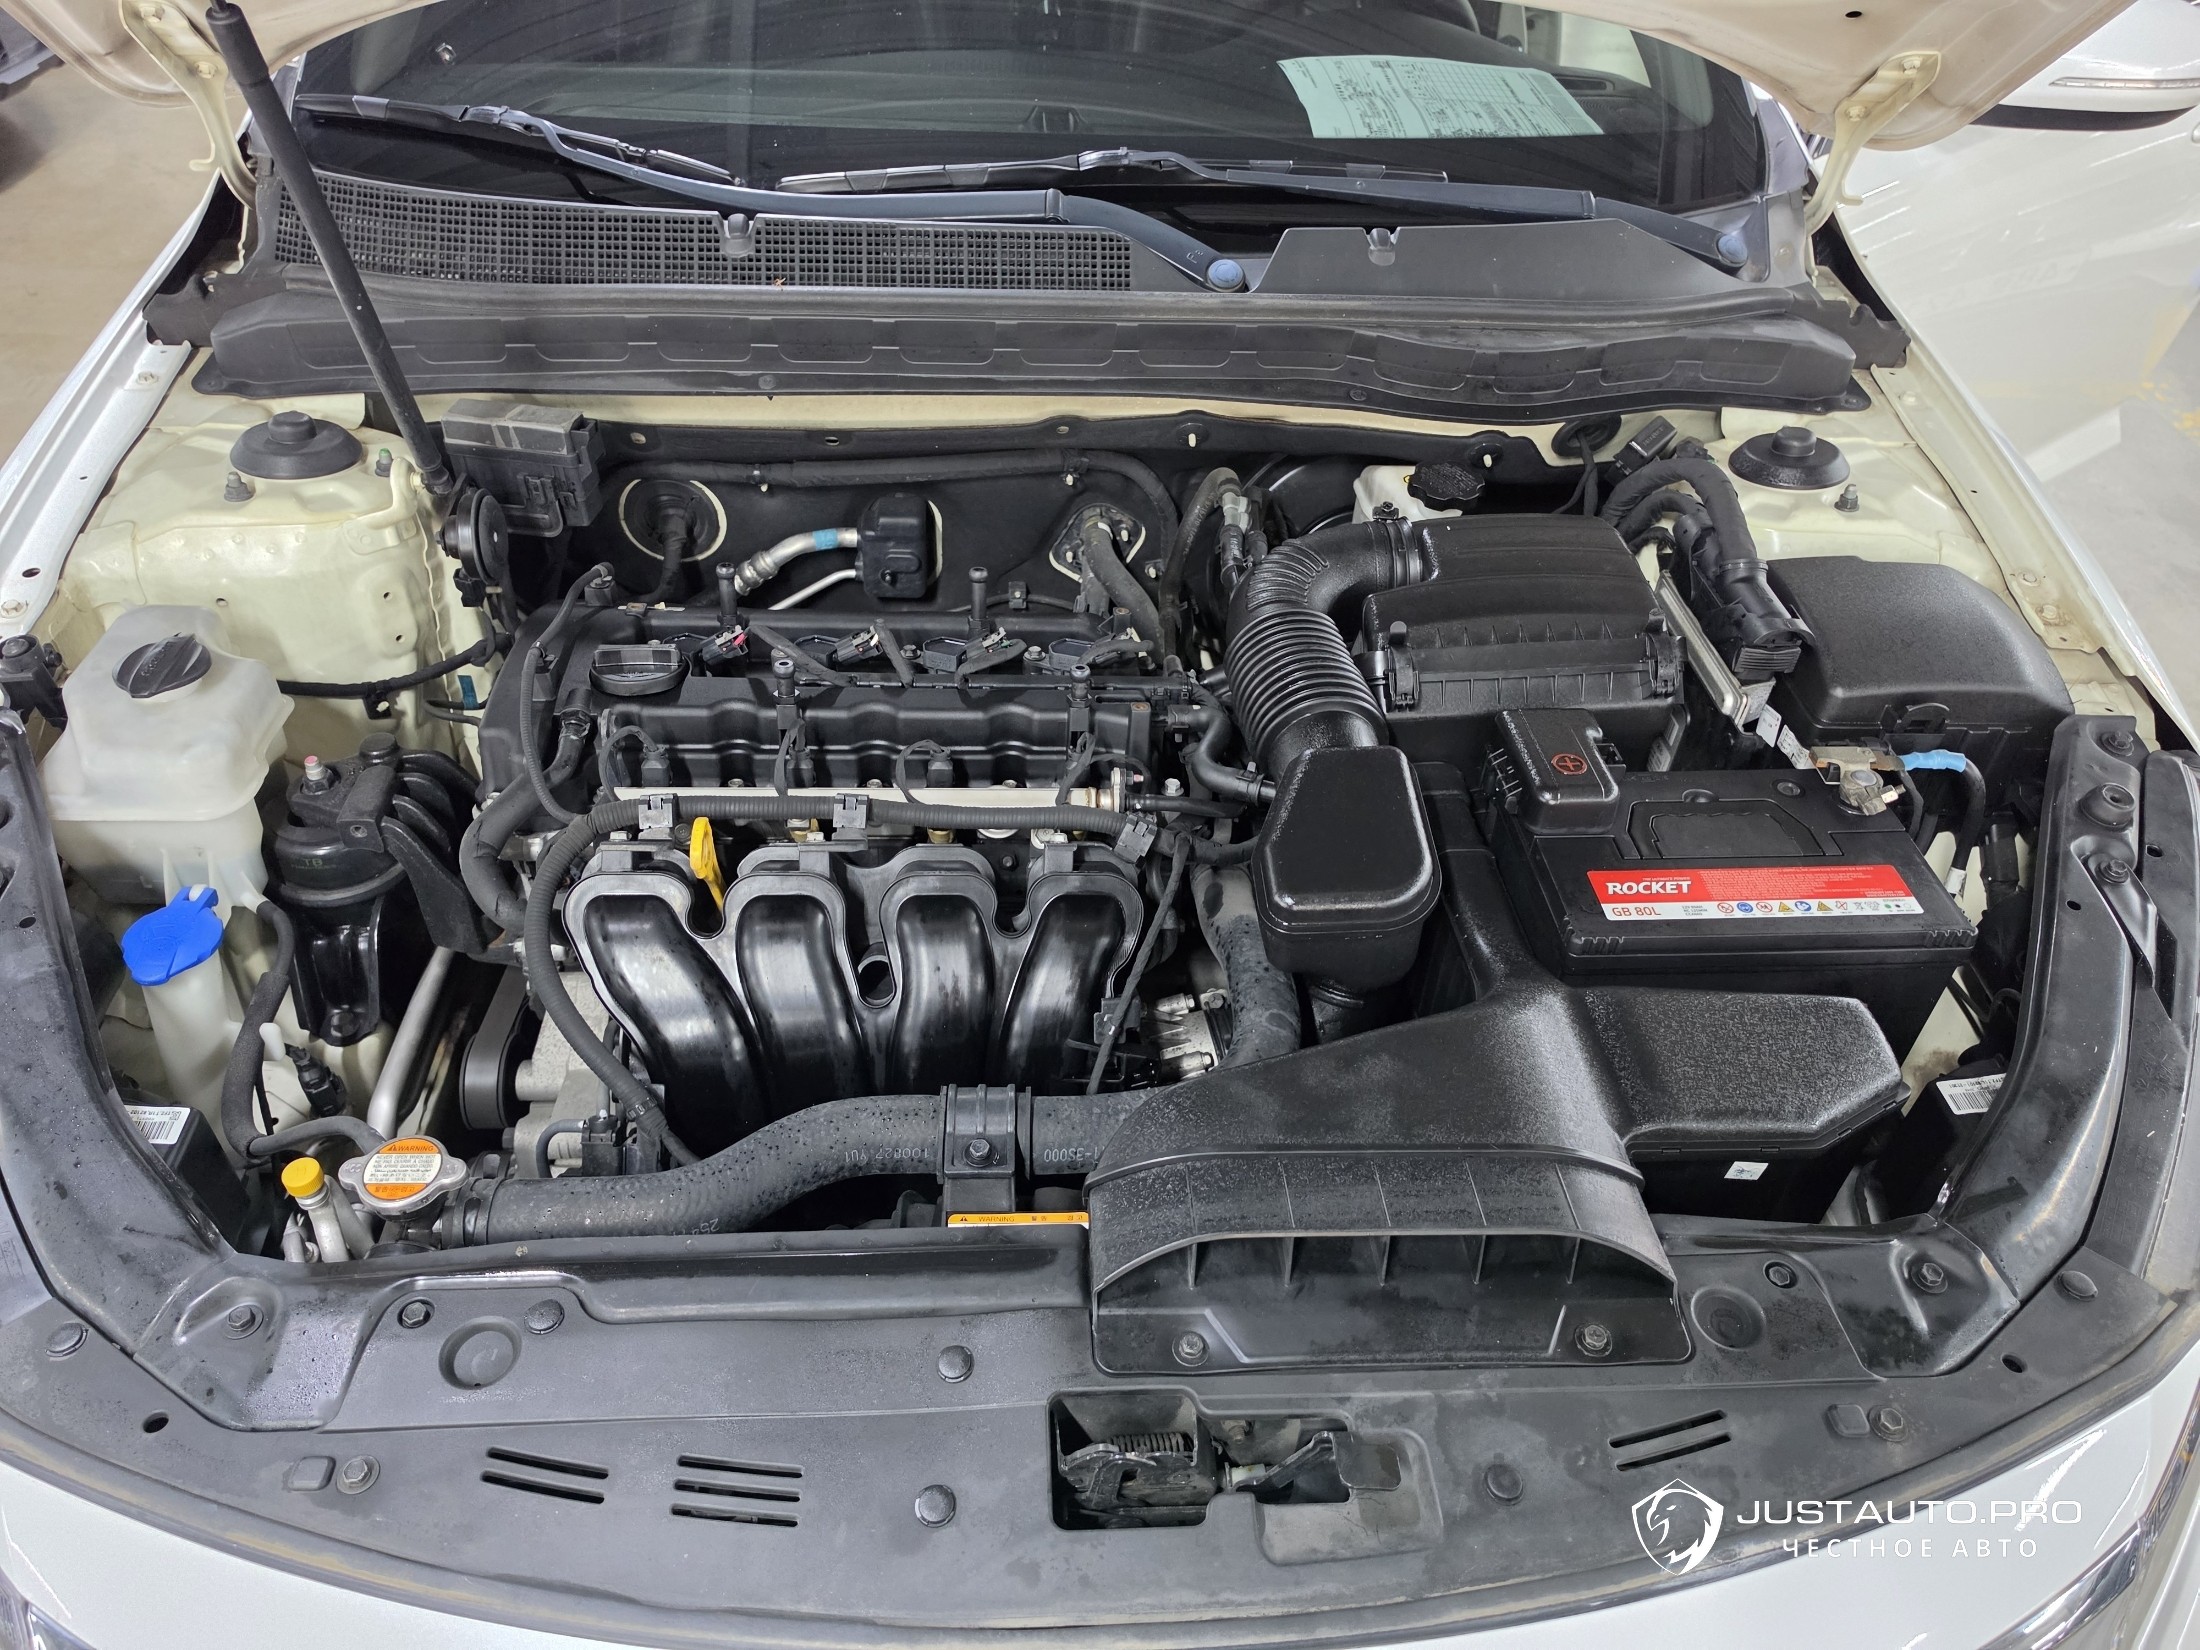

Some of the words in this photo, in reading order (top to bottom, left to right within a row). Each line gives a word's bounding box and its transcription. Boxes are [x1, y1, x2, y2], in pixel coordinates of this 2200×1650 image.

[1605, 881, 1692, 895] ROCKET
[1612, 907, 1632, 917] GB
[1634, 906, 1662, 916] 80L
